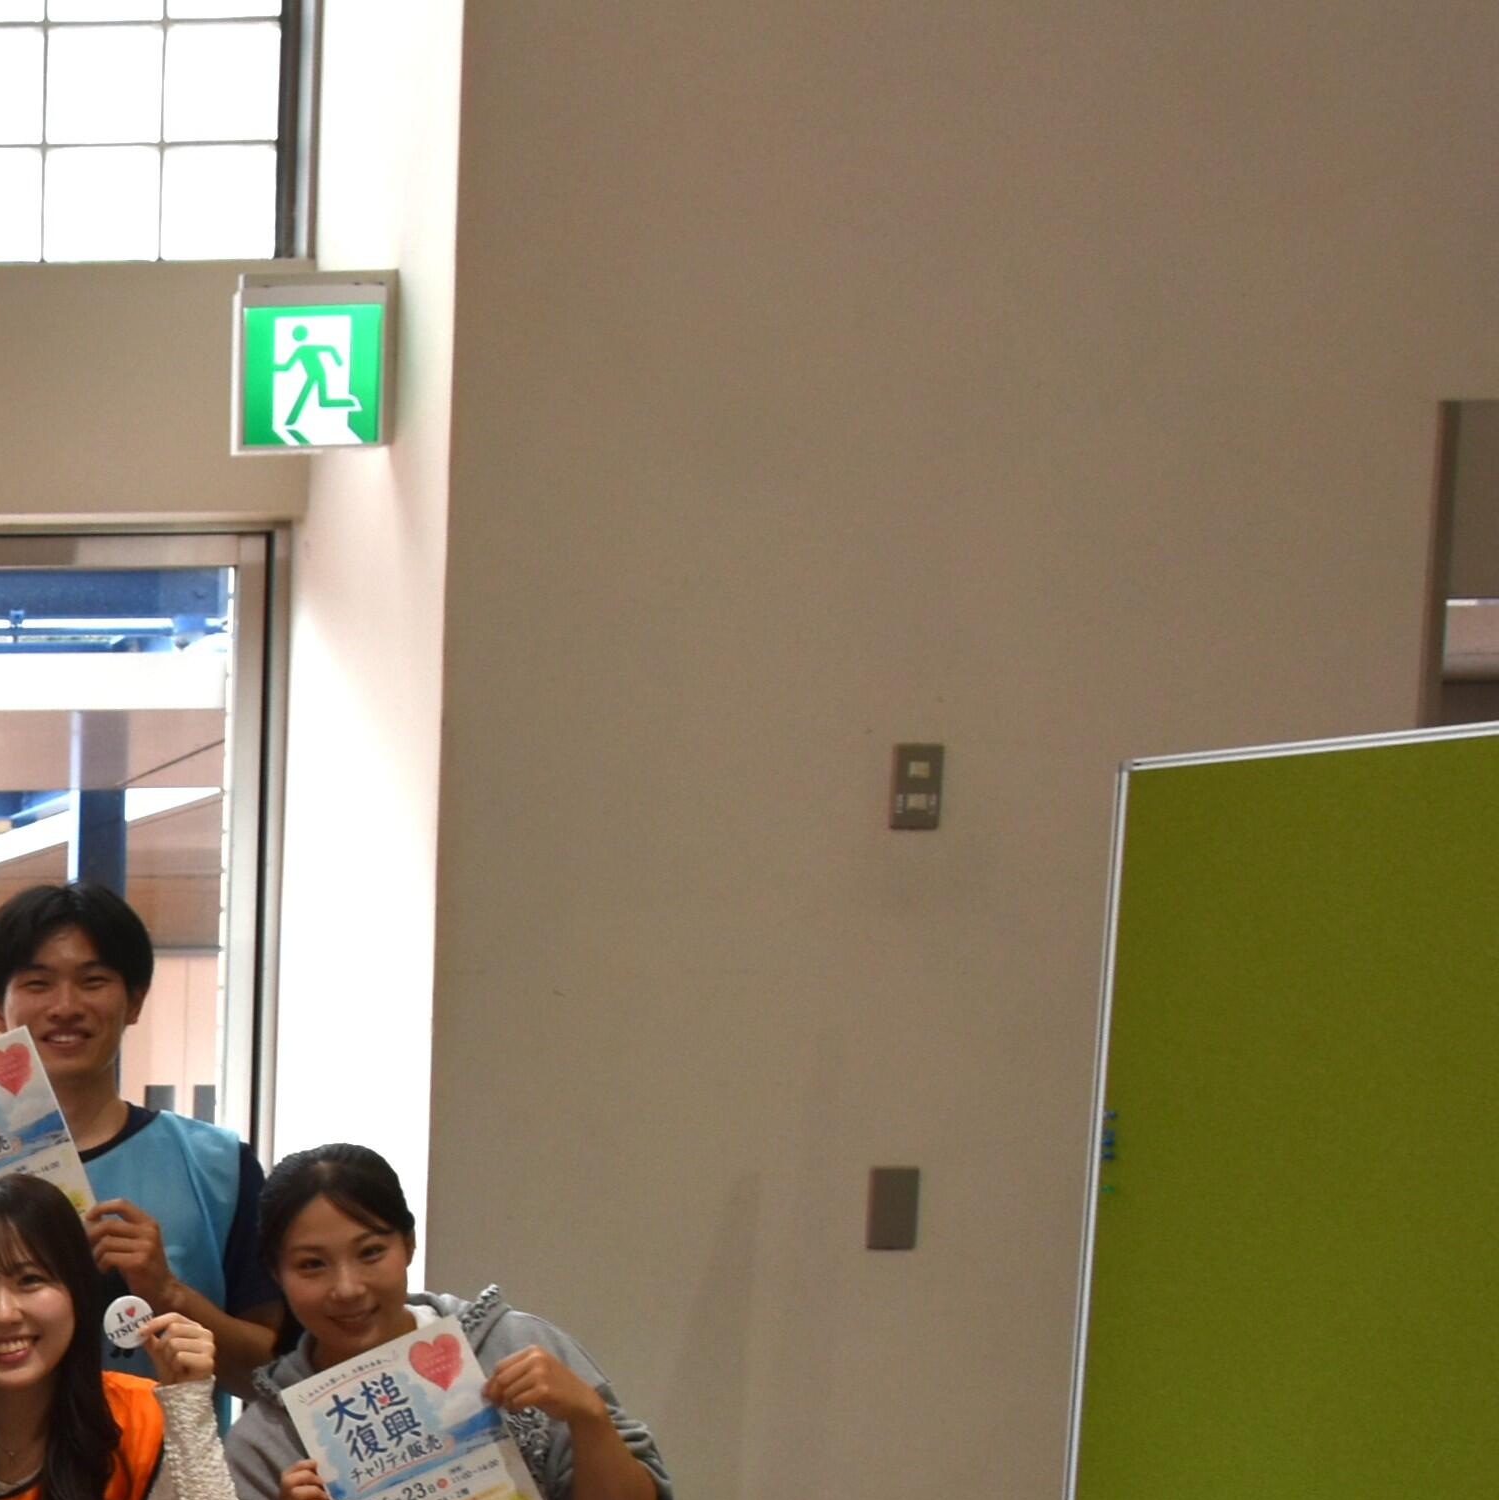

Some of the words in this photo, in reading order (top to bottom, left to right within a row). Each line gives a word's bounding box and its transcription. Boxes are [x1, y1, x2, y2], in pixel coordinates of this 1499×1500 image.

[116, 1312, 124, 1323] I
[325, 1372, 409, 1434] 大槌
[345, 1406, 422, 1462] 復興
[350, 1434, 444, 1484] チャリティ販売
